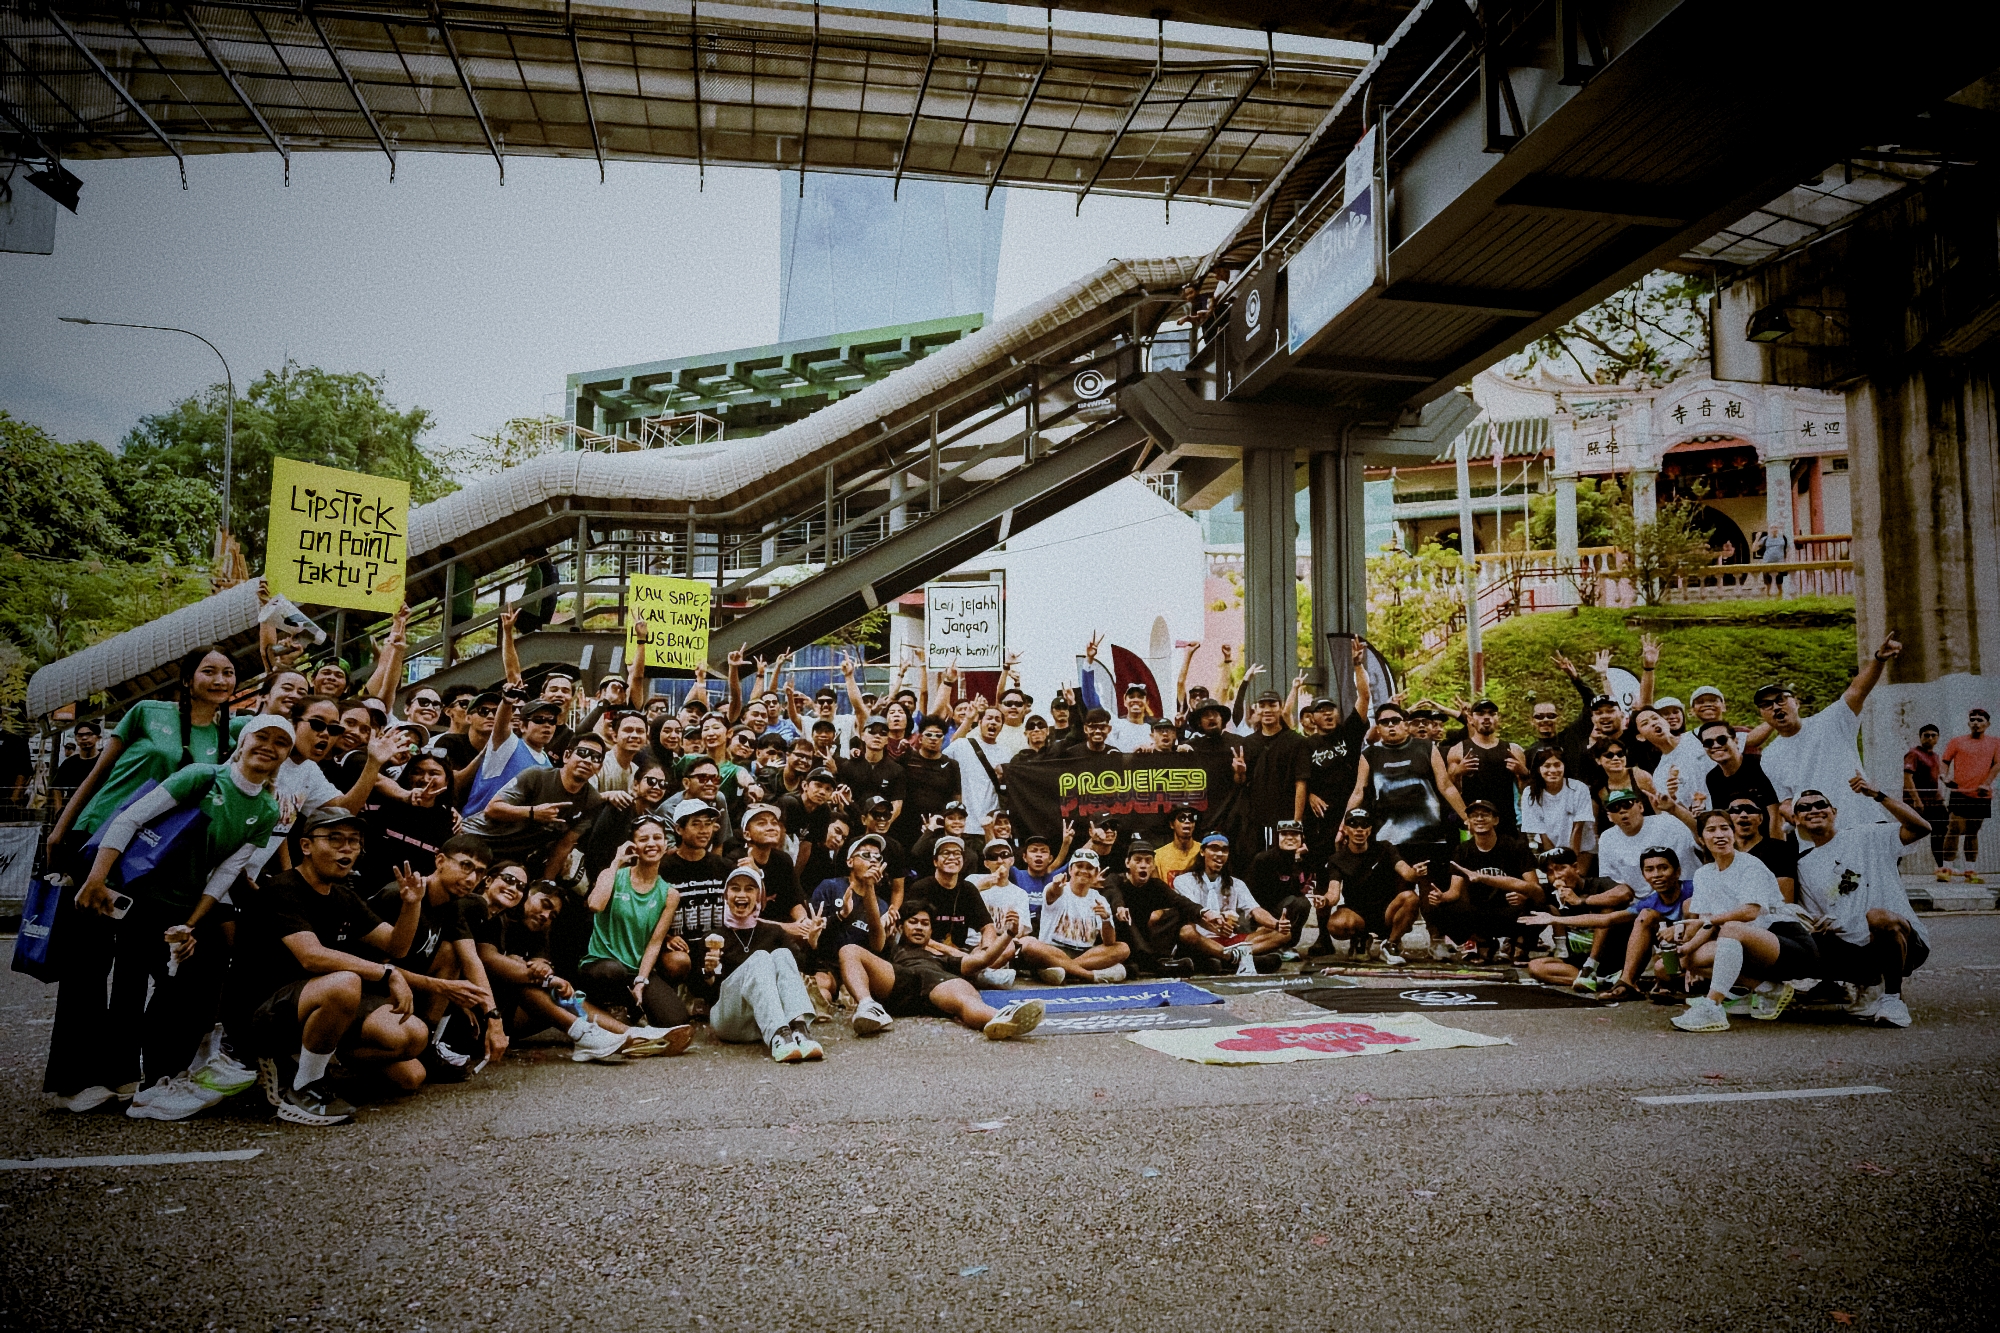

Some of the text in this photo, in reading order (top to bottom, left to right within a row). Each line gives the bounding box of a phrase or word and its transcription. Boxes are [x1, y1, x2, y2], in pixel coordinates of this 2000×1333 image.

[300, 529, 331, 554] on
[635, 585, 709, 612] KAU SAPE?
[669, 611, 708, 632] TANYA
[941, 617, 989, 639] Jangan
[1058, 768, 1207, 797] PROJEK59
